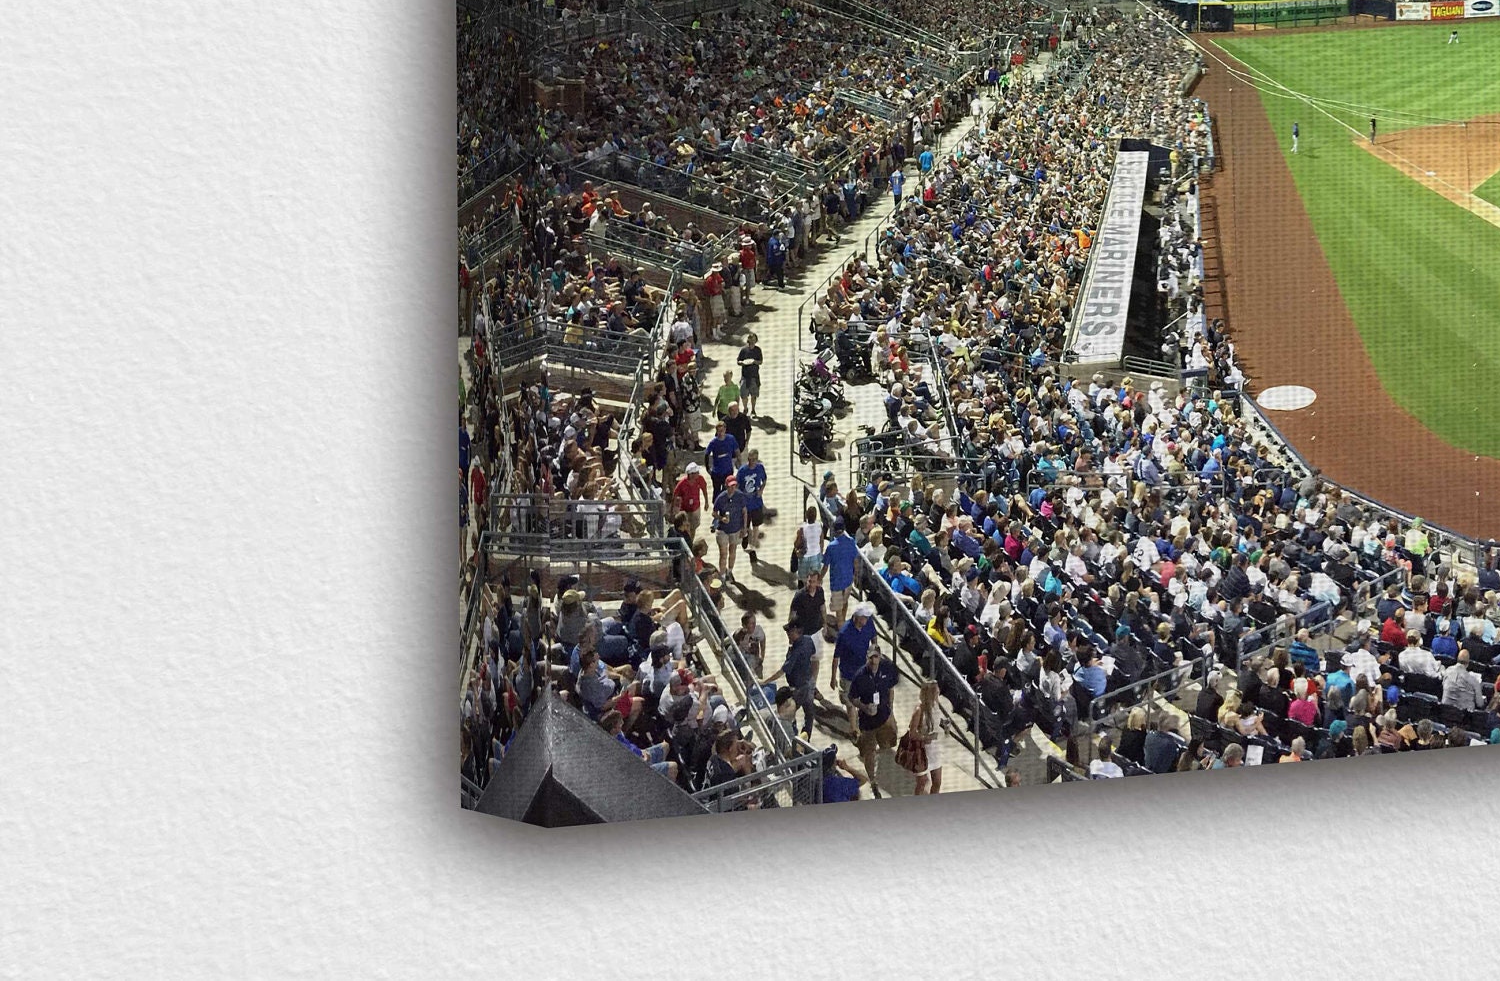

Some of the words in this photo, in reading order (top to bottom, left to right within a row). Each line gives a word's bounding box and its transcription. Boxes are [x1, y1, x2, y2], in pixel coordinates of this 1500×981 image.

[1431, 4, 1464, 17] TAGLIANI
[1110, 160, 1143, 217] SEATTLE
[1080, 223, 1132, 337] MARINERS
